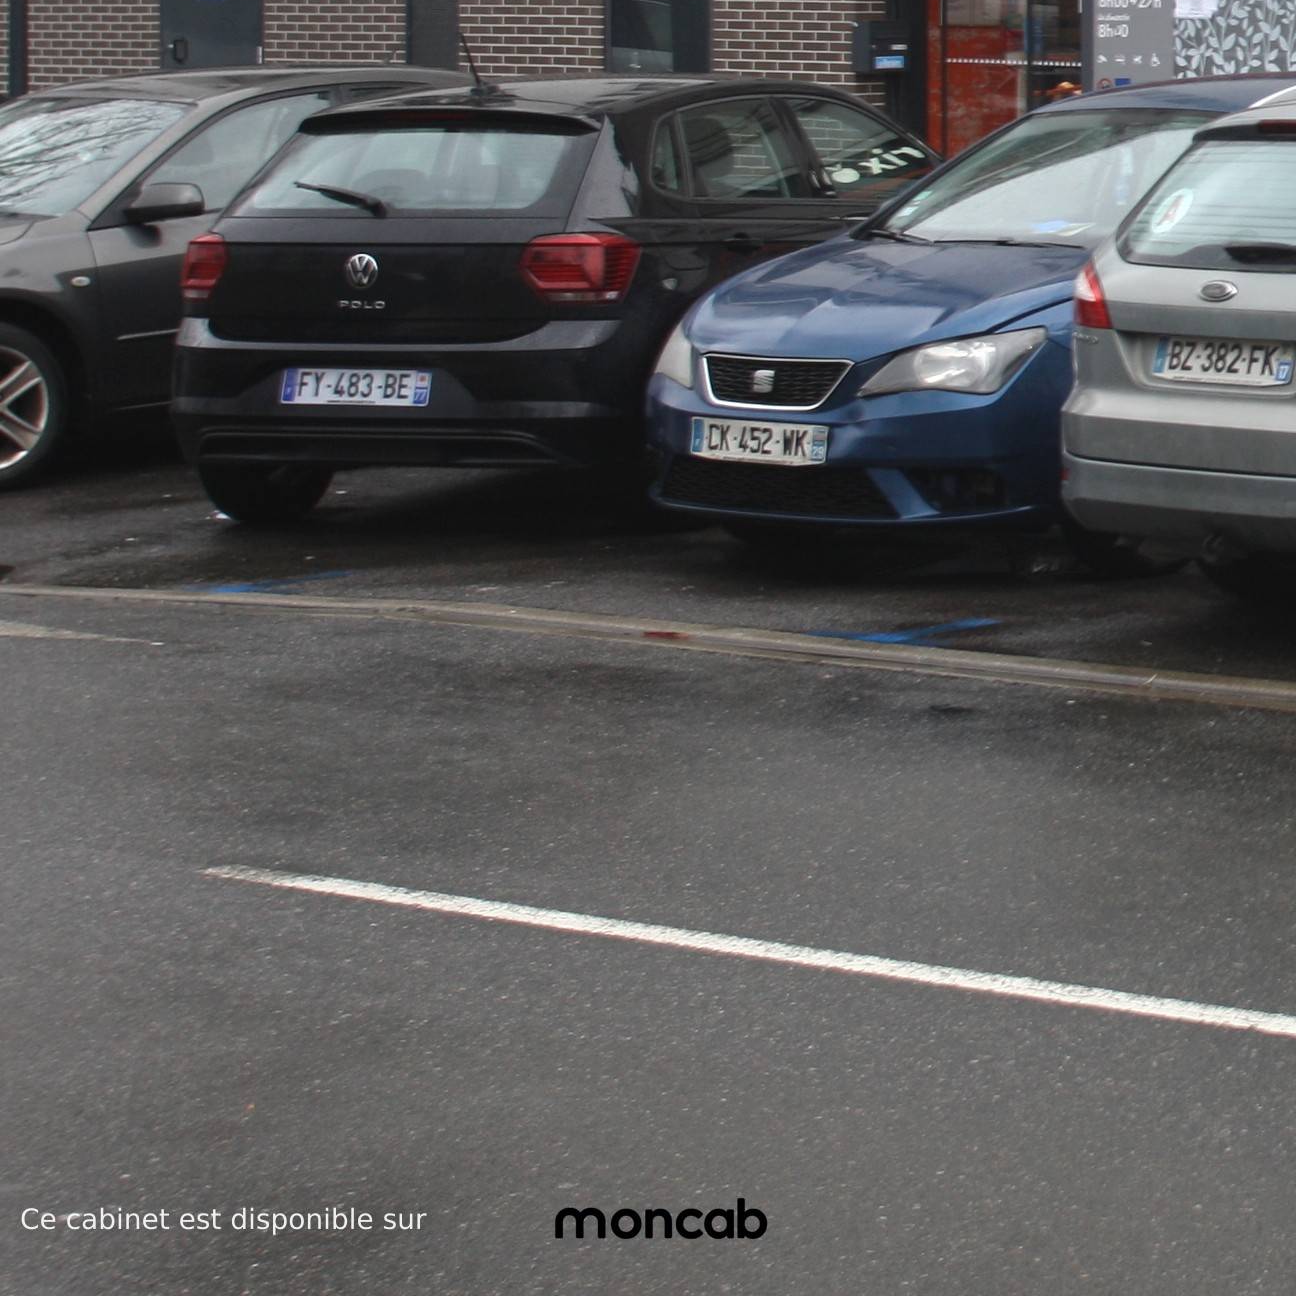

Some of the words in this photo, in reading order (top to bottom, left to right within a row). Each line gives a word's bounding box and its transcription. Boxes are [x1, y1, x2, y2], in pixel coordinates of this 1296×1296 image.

[338, 300, 386, 309] POLO
[298, 371, 411, 400] FY-483-BE
[414, 389, 427, 400] 77
